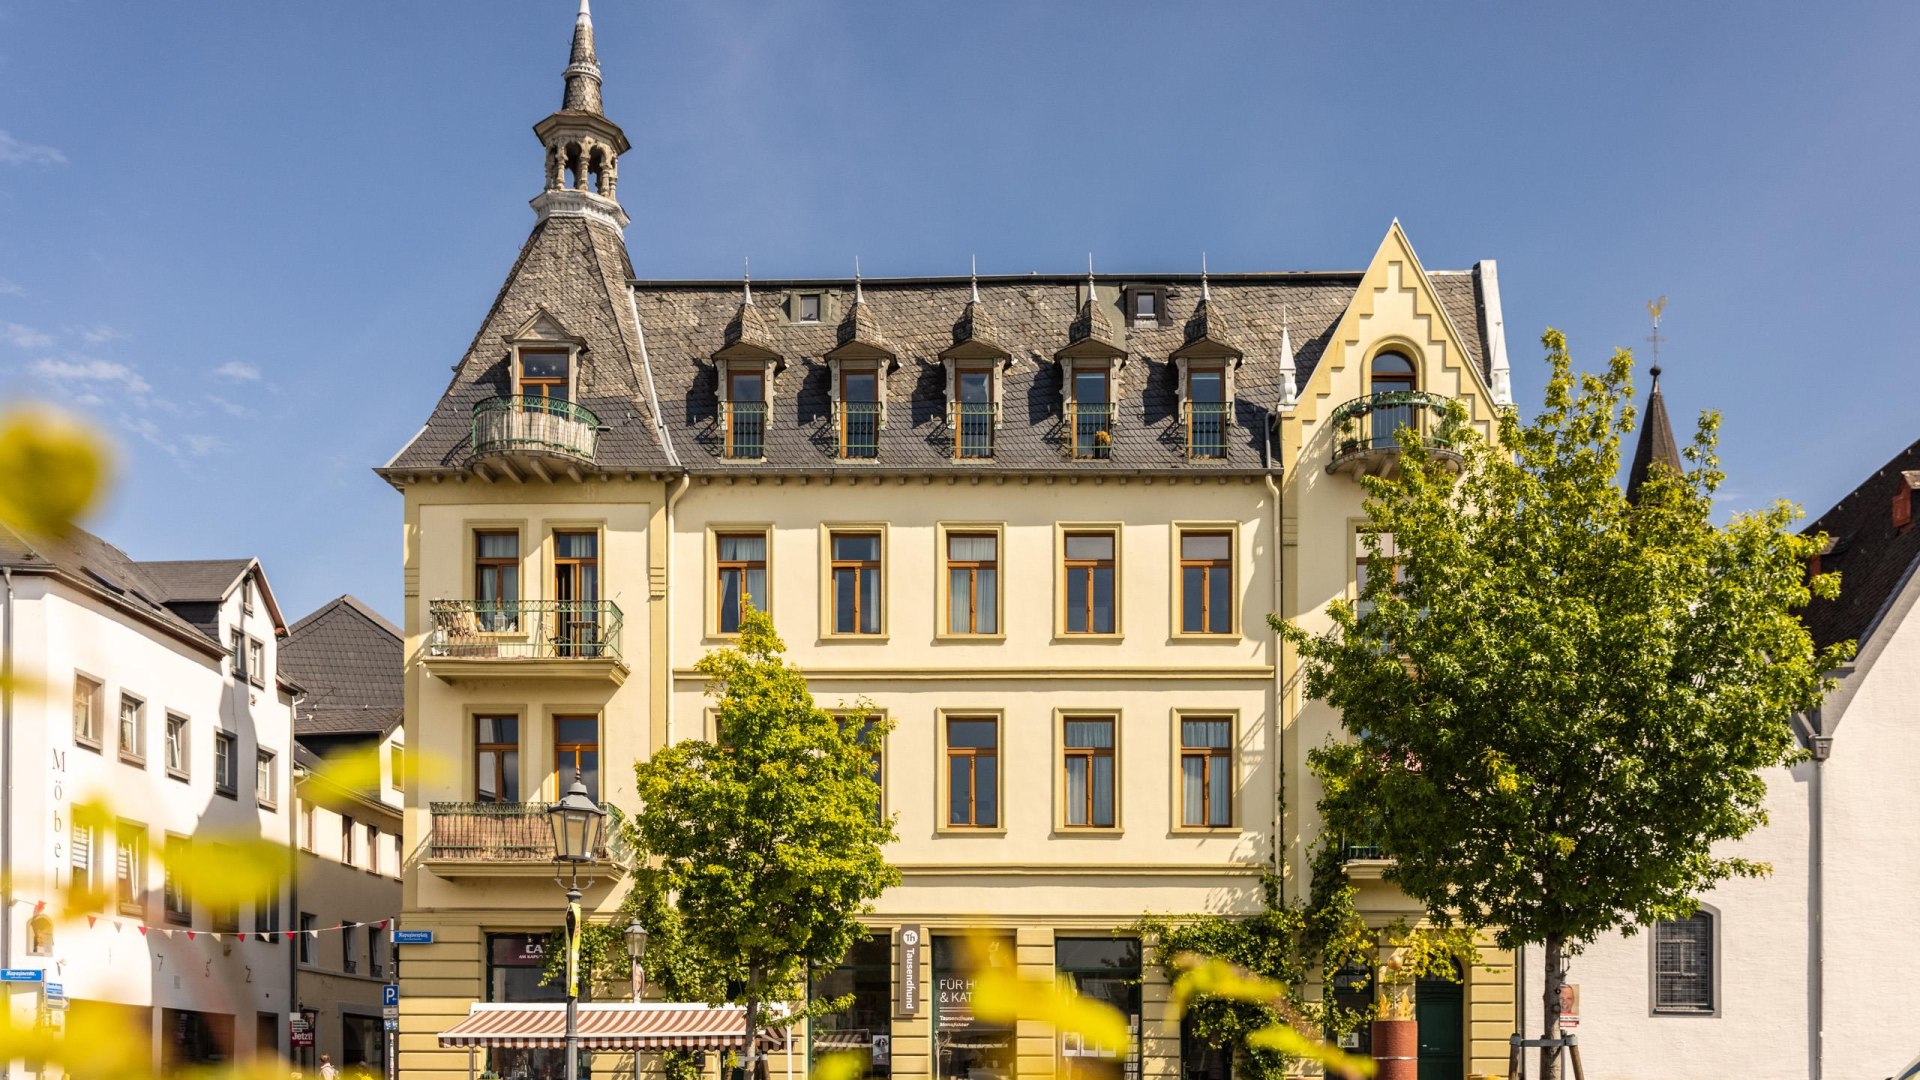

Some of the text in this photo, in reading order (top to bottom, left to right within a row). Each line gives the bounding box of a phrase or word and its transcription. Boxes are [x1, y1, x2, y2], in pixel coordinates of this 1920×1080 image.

[52, 748, 65, 889] Möbel
[906, 948, 916, 1009] Tausendhund
[940, 977, 964, 990] FÜR
[386, 987, 396, 1004] P
[940, 991, 949, 1003] &
[291, 1032, 313, 1040] Jetzt!
